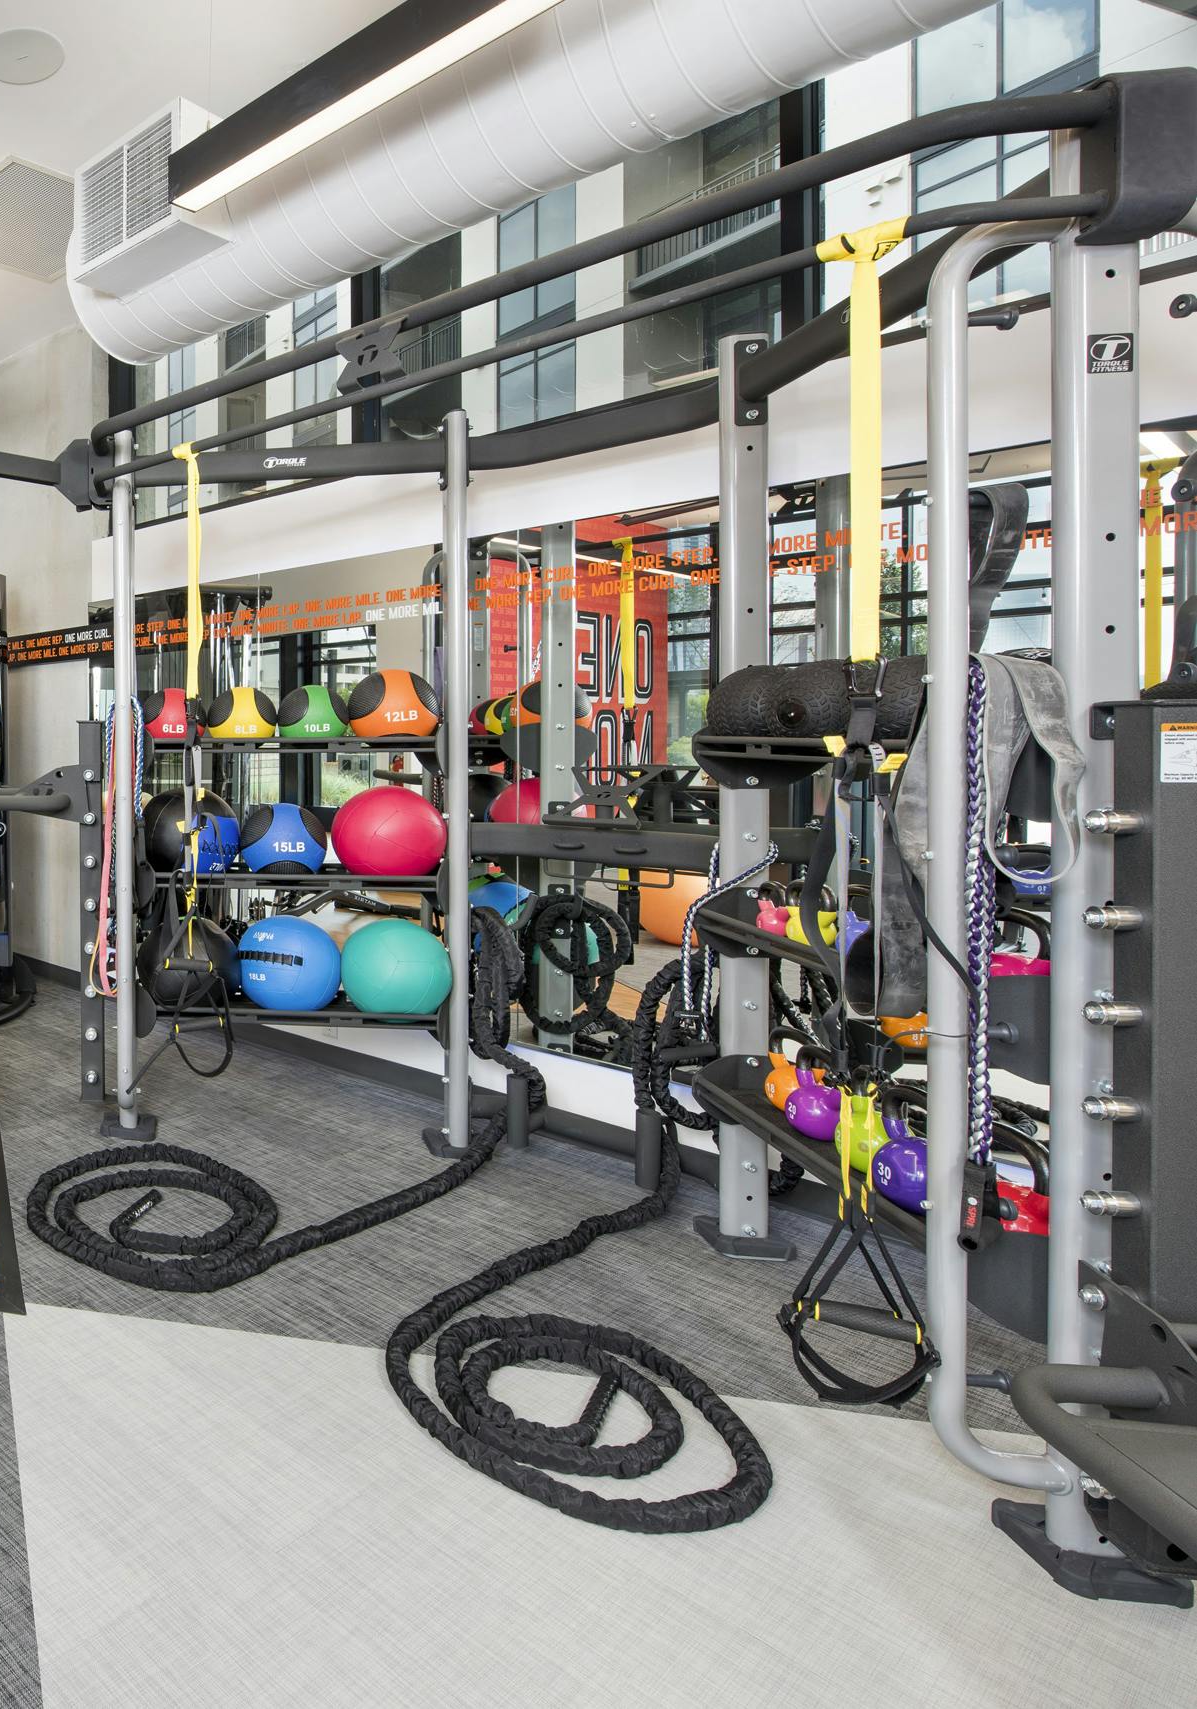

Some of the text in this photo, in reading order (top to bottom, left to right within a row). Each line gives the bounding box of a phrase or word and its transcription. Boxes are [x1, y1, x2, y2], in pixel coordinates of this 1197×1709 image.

[263, 456, 307, 469] TORQUE
[59, 646, 70, 657] ONE
[70, 644, 86, 655] MORE
[87, 642, 101, 653] REP.
[102, 640, 114, 651] ONE
[365, 608, 386, 622] ONE
[389, 603, 419, 619] MORE
[422, 601, 444, 615] MIL
[560, 584, 586, 601] ONE
[592, 579, 634, 597] MORE
[639, 574, 685, 592] CURL.
[691, 568, 720, 585] ONE
[787, 554, 840, 576] STEP.
[1140, 511, 1197, 537] MOR
[65, 633, 76, 644] ONE
[76, 631, 93, 642] MORE
[94, 628, 112, 639] CURL.
[355, 592, 383, 606] MILE.
[386, 589, 407, 603] ONE
[410, 583, 443, 600] MORE
[588, 559, 617, 577] ONE
[621, 553, 666, 574] MORE
[671, 547, 718, 567] STEP.
[769, 532, 818, 555] MORE
[384, 711, 419, 723] 12LB
[162, 723, 184, 734] 6LB
[235, 725, 258, 735] 8LB
[304, 723, 330, 733] 10LB
[273, 841, 306, 853] 15LB
[788, 1102, 797, 1115] 20
[877, 1162, 892, 1180] 30
